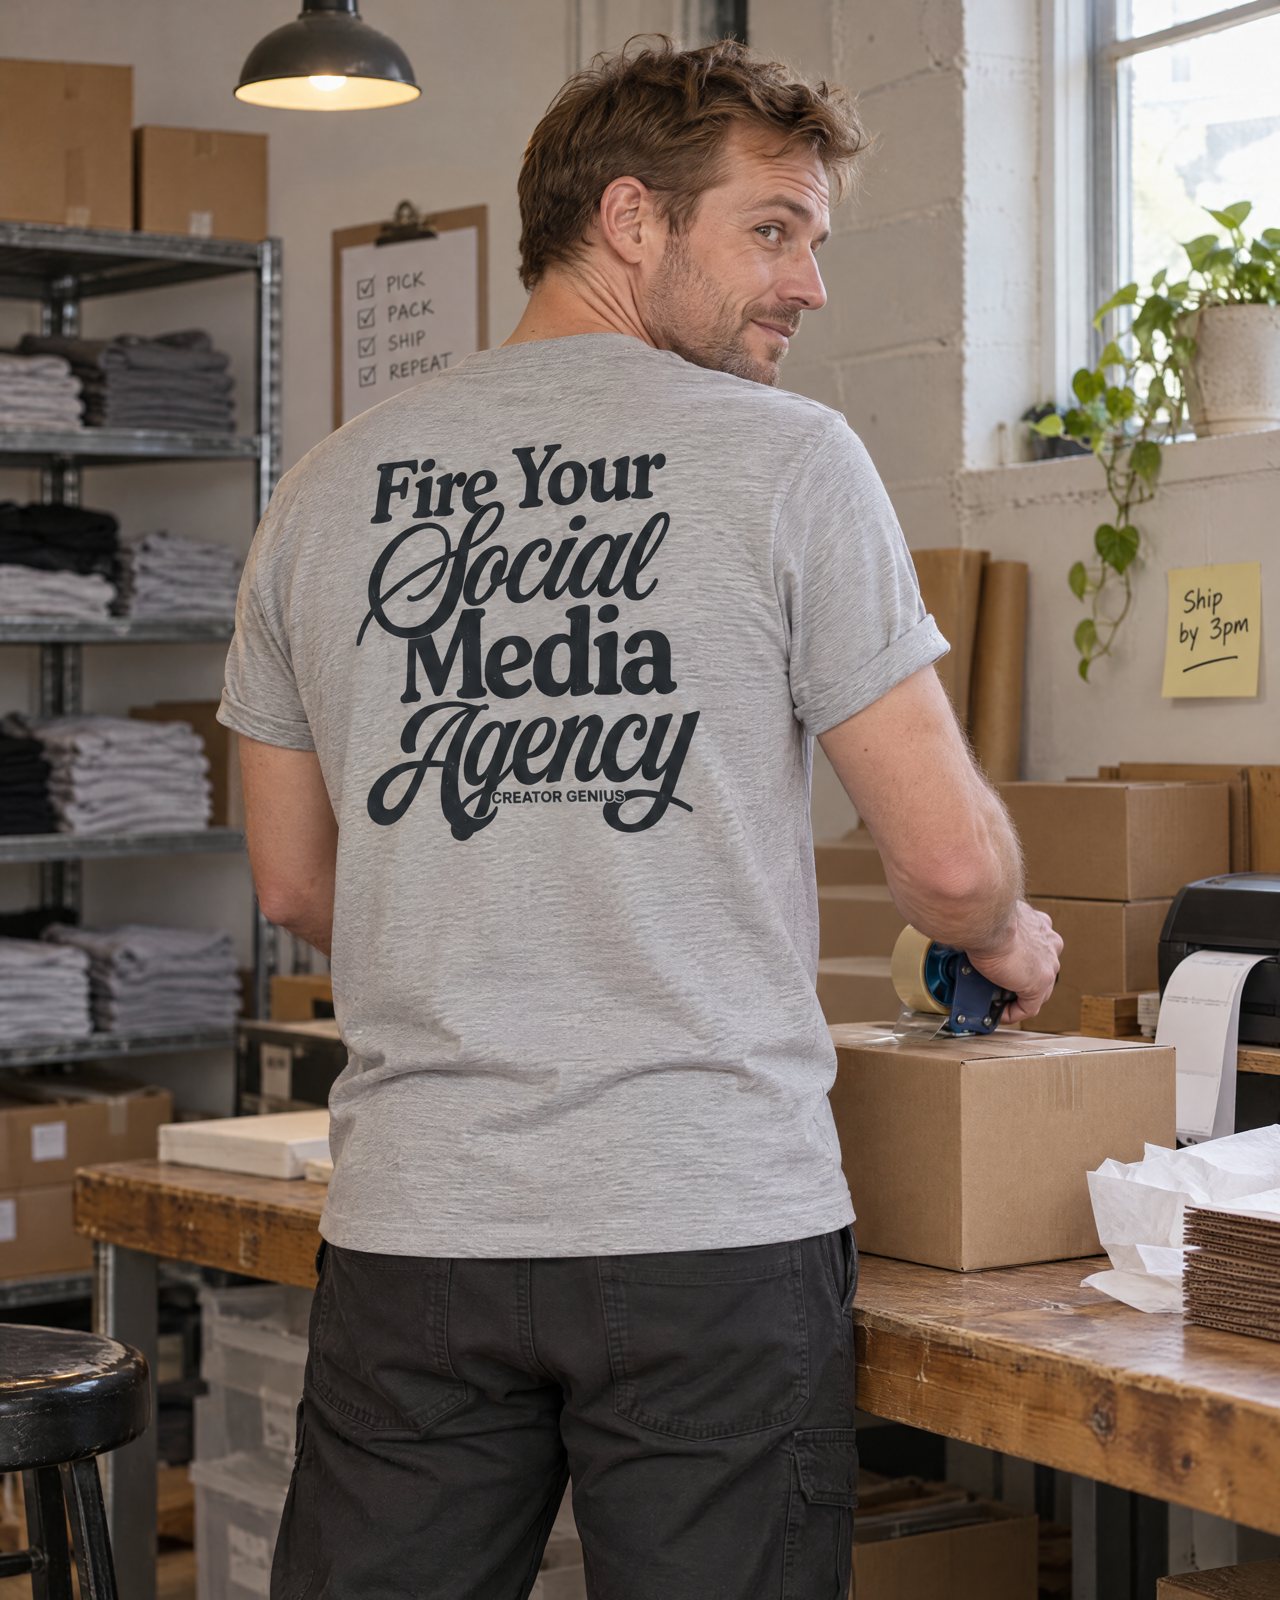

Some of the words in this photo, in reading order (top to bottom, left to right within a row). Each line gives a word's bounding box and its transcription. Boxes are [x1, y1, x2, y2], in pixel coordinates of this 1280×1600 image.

[386, 271, 425, 293] PICK
[388, 298, 434, 322] PACK
[388, 330, 426, 351] SHIP
[389, 352, 452, 379] REPEAT
[370, 459, 498, 524] Fire
[511, 443, 666, 509] Your
[356, 501, 670, 646] Social
[1183, 587, 1223, 616] Ship
[1179, 622, 1199, 652] by
[1210, 617, 1249, 646] 3pm
[400, 603, 677, 703] Media
[367, 701, 700, 841] Agency
[491, 791, 563, 804] CREATOR
[567, 789, 625, 803] GENIUS
